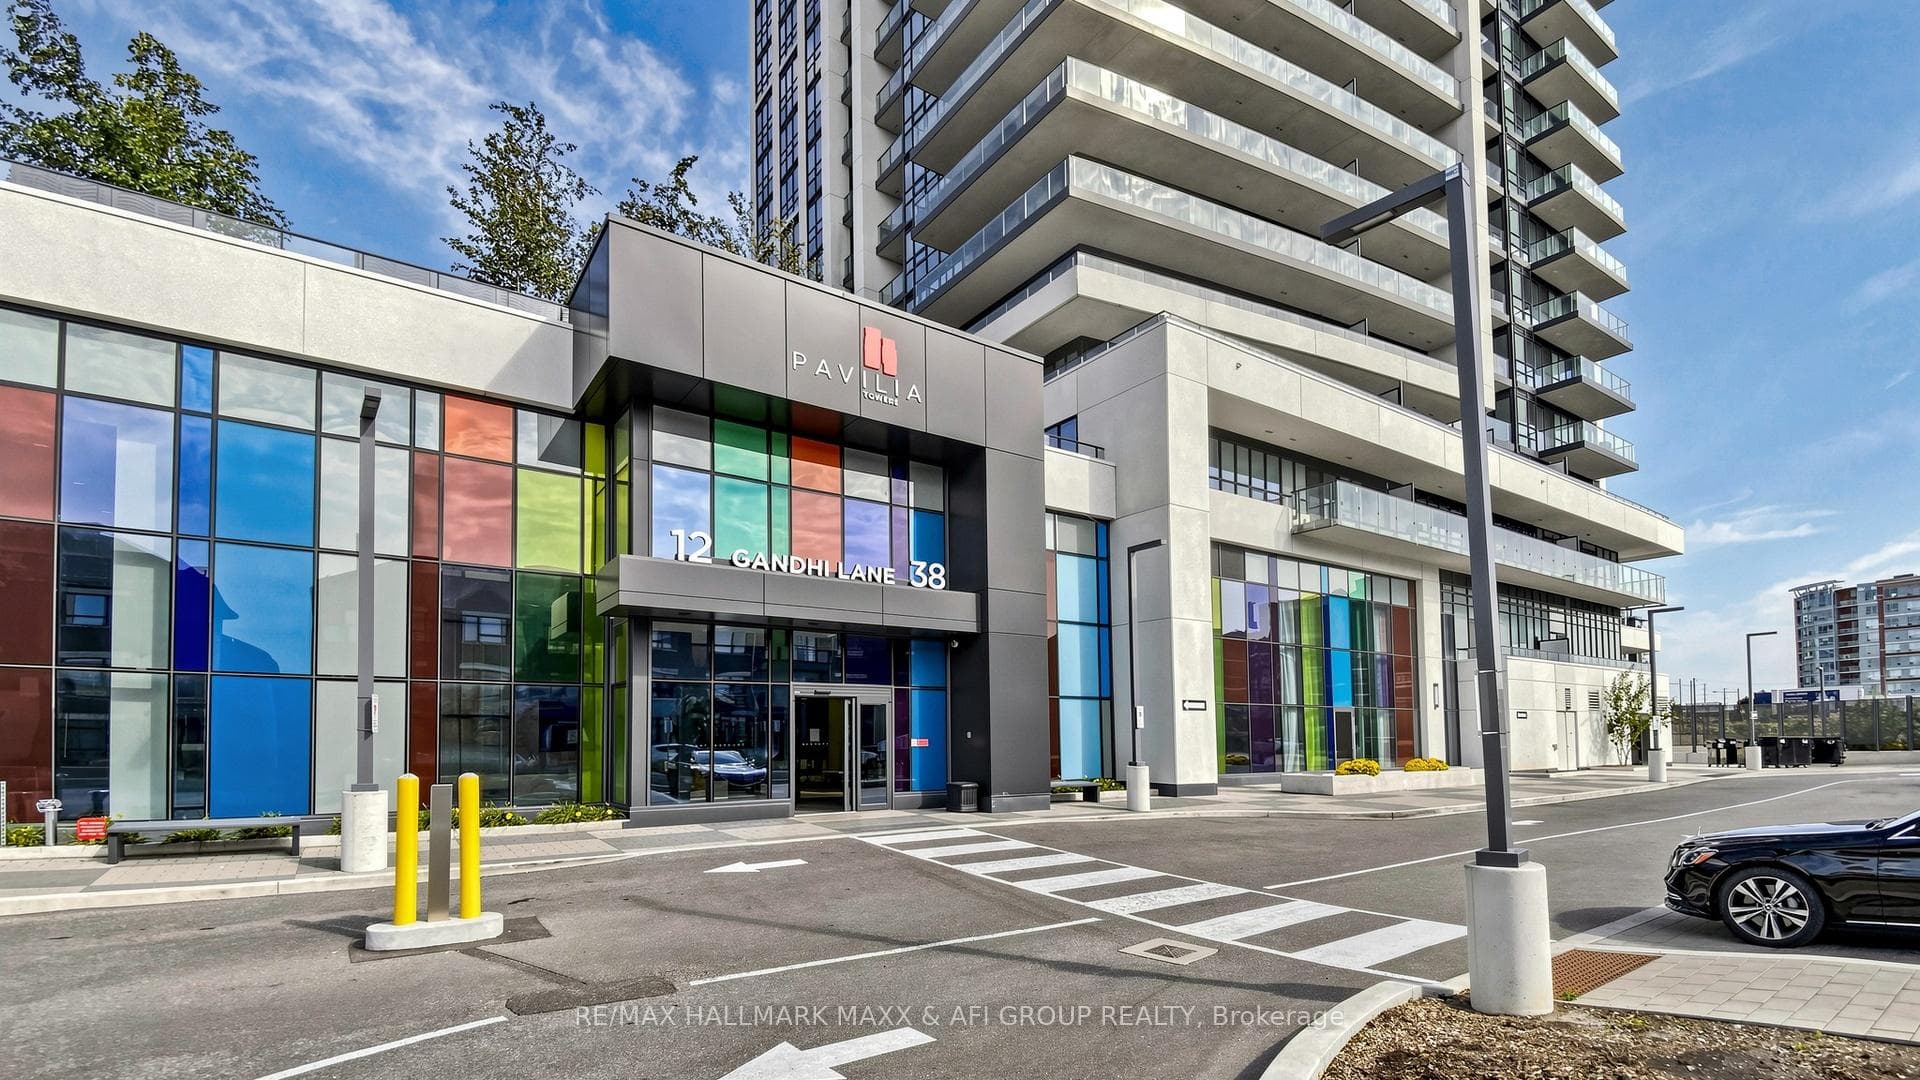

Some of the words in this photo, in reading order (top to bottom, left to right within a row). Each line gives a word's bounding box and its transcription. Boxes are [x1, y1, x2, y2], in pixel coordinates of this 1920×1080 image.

[792, 350, 922, 404] PAVILIA
[670, 528, 713, 564] 12
[731, 548, 830, 577] GANDHI
[837, 560, 896, 585] LANE
[909, 560, 946, 590] 38
